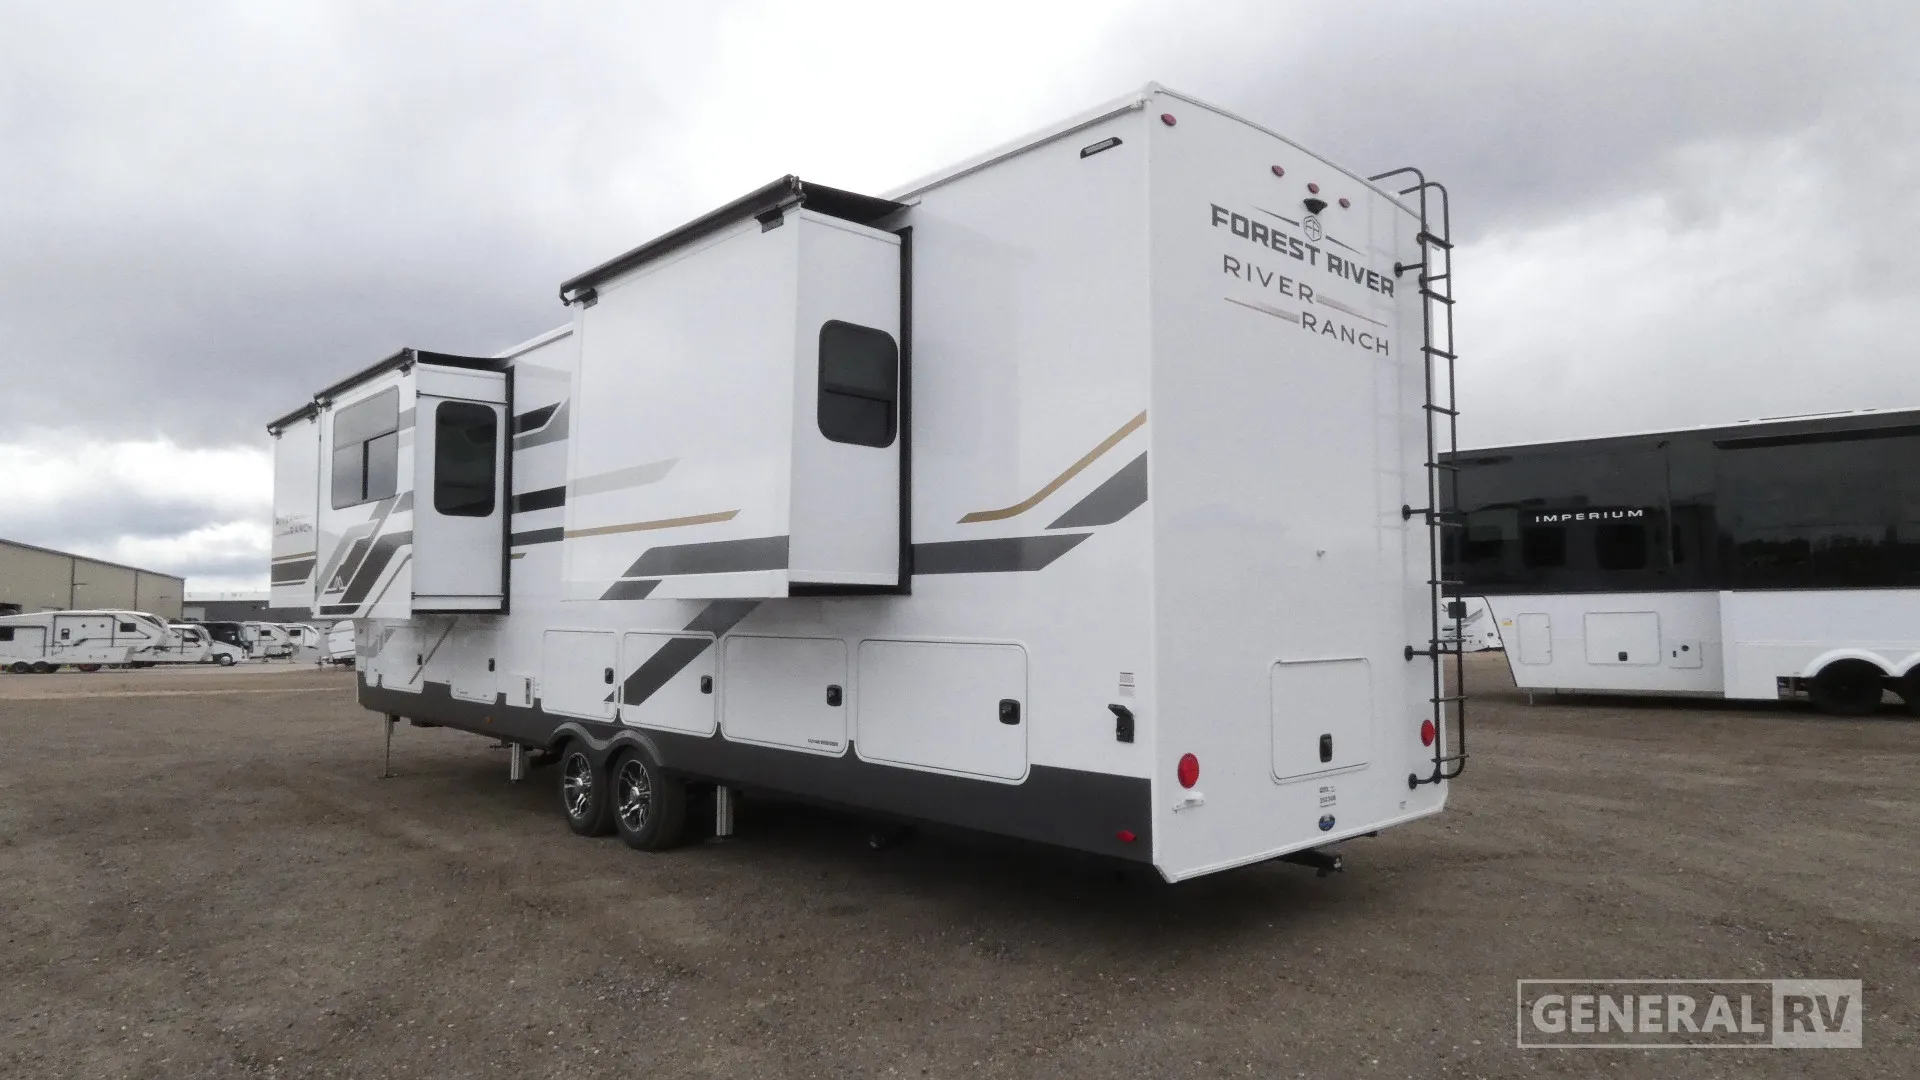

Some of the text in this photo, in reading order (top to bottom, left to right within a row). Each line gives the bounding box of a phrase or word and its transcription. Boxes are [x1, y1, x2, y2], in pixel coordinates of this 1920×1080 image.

[1210, 203, 1394, 298] FOREST RIVER
[1223, 254, 1314, 304] RIVER
[1302, 311, 1389, 356] RANCH
[1535, 509, 1643, 523] IMPERIUM
